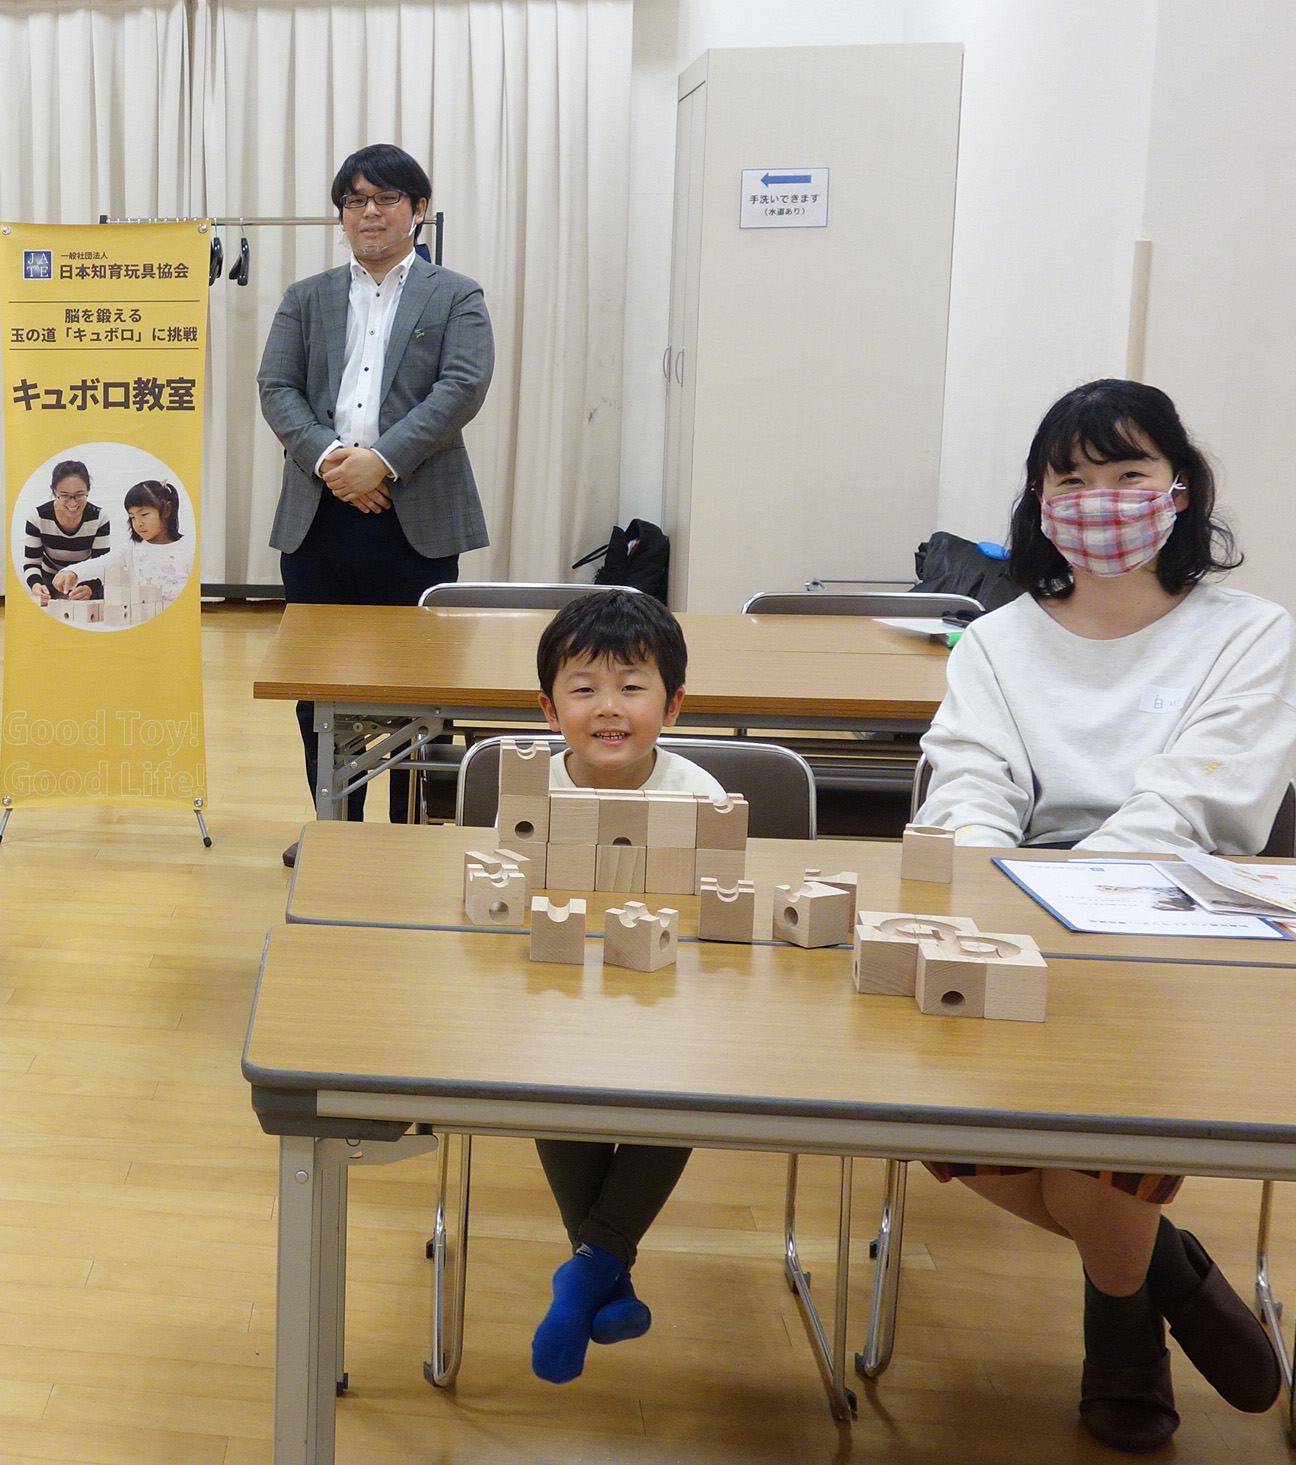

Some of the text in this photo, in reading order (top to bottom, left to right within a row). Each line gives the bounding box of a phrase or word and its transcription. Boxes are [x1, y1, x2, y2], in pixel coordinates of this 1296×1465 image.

[750, 194, 820, 204] 手洗いできます
[61, 251, 109, 260] 一般社団法人
[59, 263, 190, 280] 日本知育玩具協会
[64, 308, 142, 324] 脳を鍛える
[10, 327, 198, 343] 玉の道「キュボロ」に挑戦
[12, 377, 196, 412] キュボロ教室
[3, 709, 200, 756] Good Toy!
[3, 760, 207, 798] Good Life!
